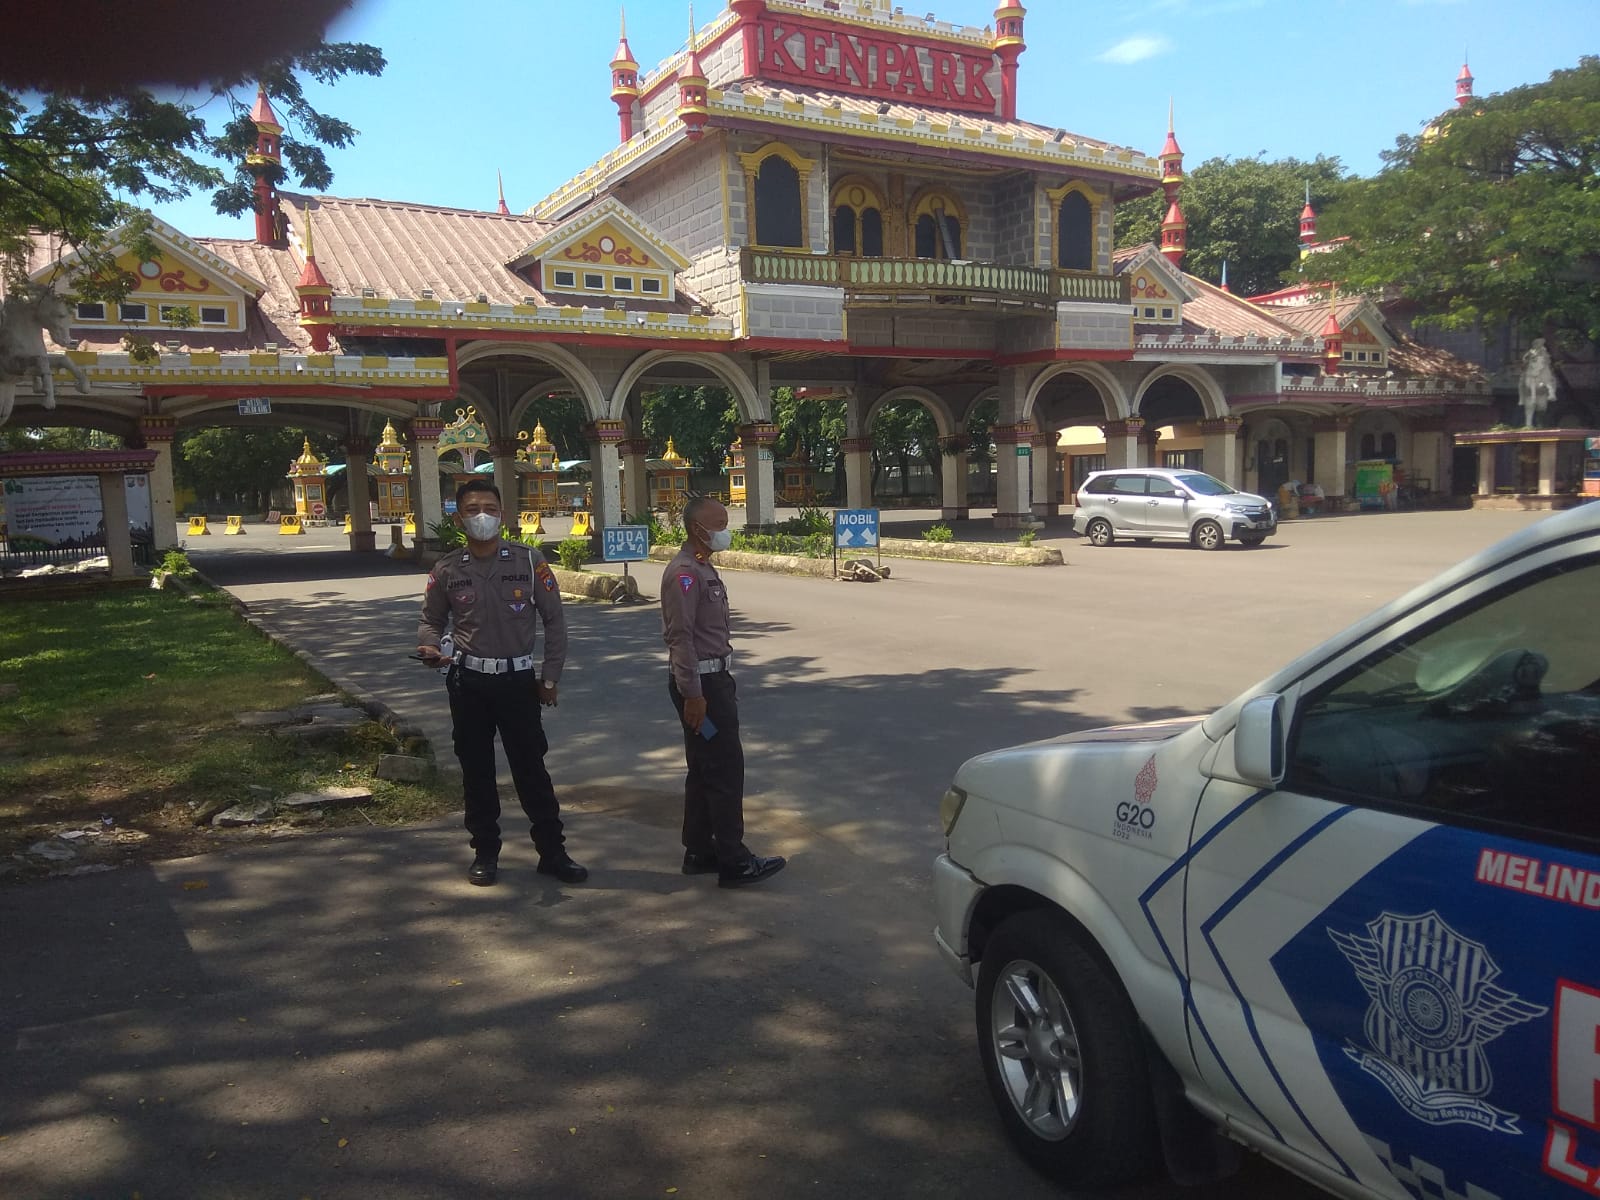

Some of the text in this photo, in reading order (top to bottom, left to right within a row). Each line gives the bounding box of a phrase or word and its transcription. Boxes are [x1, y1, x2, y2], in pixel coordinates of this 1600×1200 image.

[760, 19, 996, 105] KENPARK
[839, 513, 875, 525] MOBIL
[607, 530, 645, 543] RODA
[608, 543, 643, 556] 2 4
[1116, 801, 1155, 829] G20
